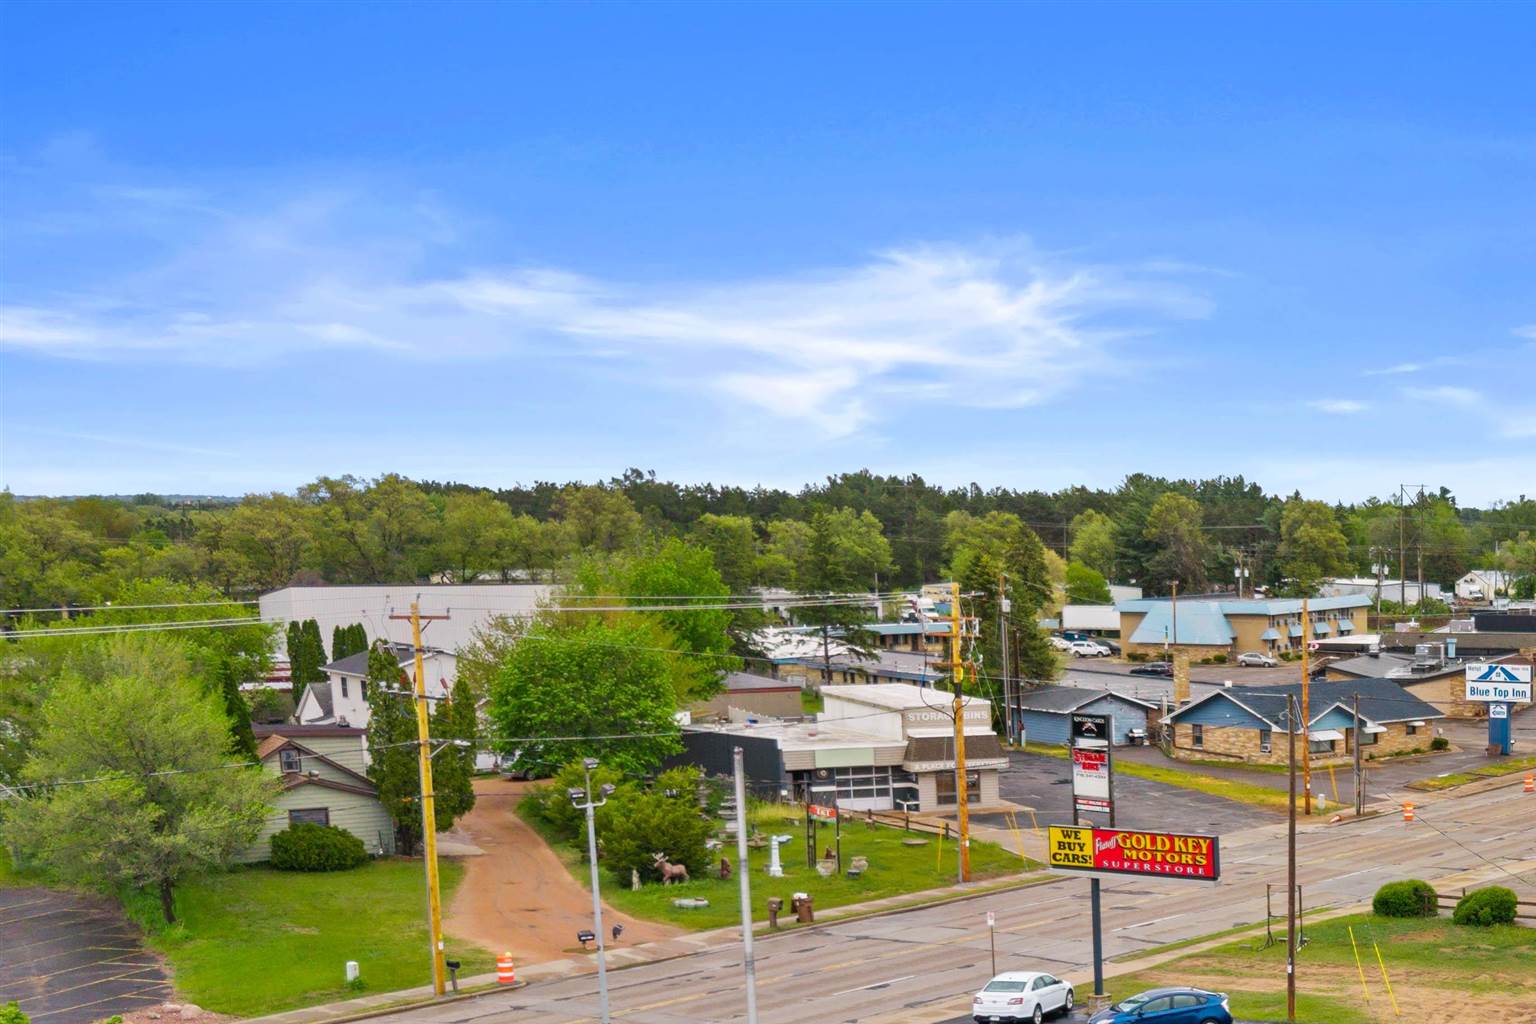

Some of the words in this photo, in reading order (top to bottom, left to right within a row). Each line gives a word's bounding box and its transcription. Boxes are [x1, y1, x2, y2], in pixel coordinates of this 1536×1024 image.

[1469, 686, 1490, 697] Blue
[1493, 687, 1509, 699] Top
[1512, 688, 1527, 699] Inn
[1060, 829, 1081, 840] WE
[1057, 841, 1086, 852] BUY
[1118, 832, 1170, 851] GOLD
[1174, 837, 1210, 854] KEY
[1052, 852, 1093, 864] CARS!
[1123, 849, 1207, 866] MOTORS
[1102, 860, 1205, 875] SUPERSTORE
